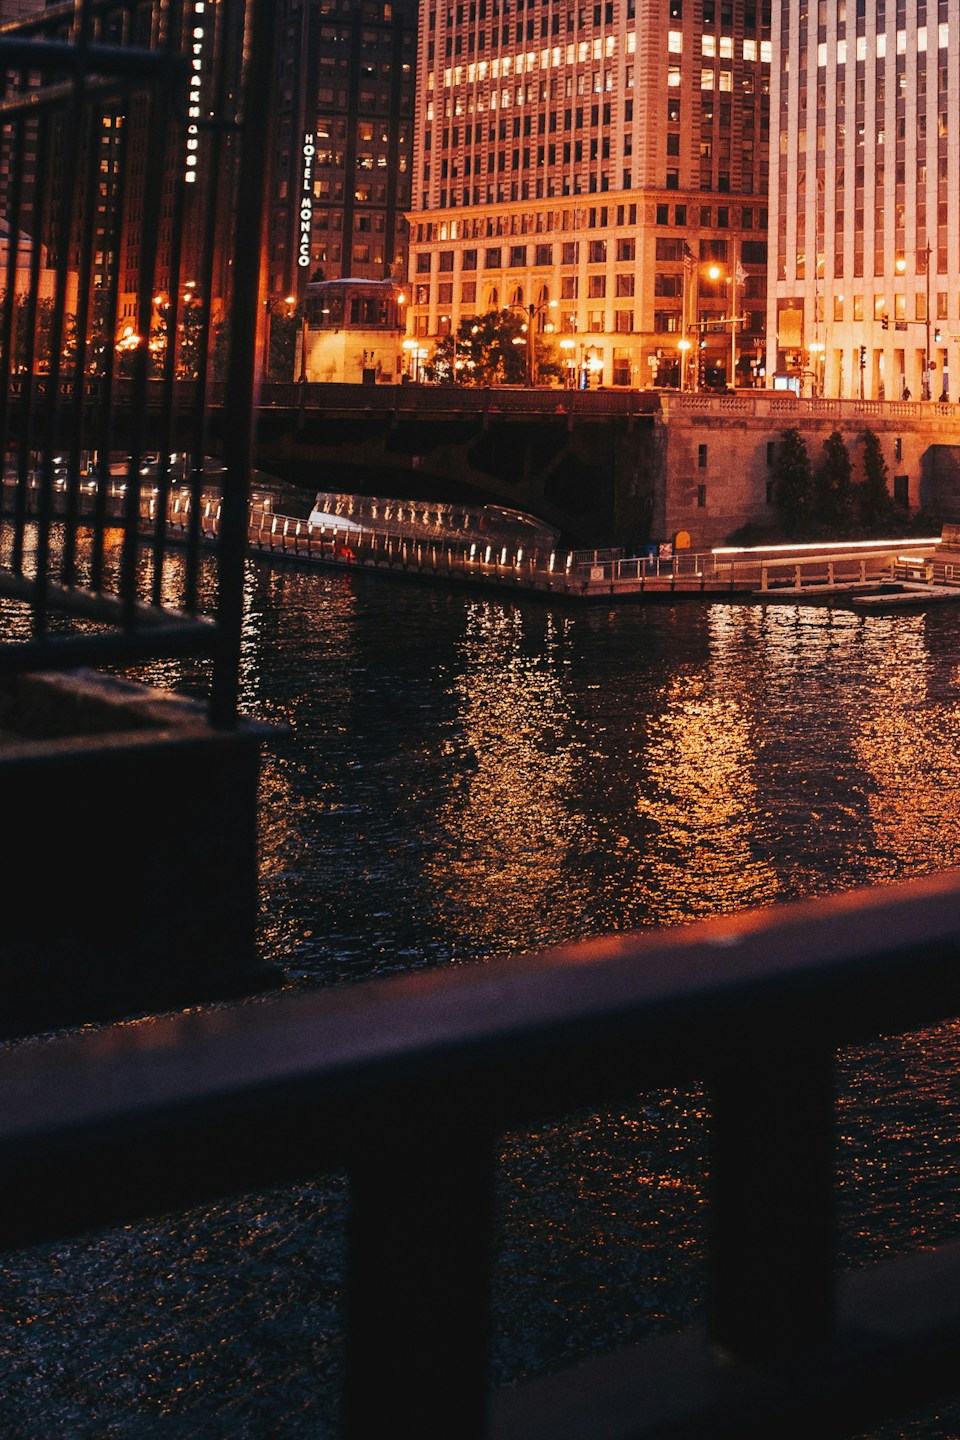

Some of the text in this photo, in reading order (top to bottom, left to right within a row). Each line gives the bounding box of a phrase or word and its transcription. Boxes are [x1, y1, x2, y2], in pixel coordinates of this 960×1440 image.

[185, 27, 204, 182] STEAKHOUSE
[298, 134, 315, 267] HOTEL MONACO
